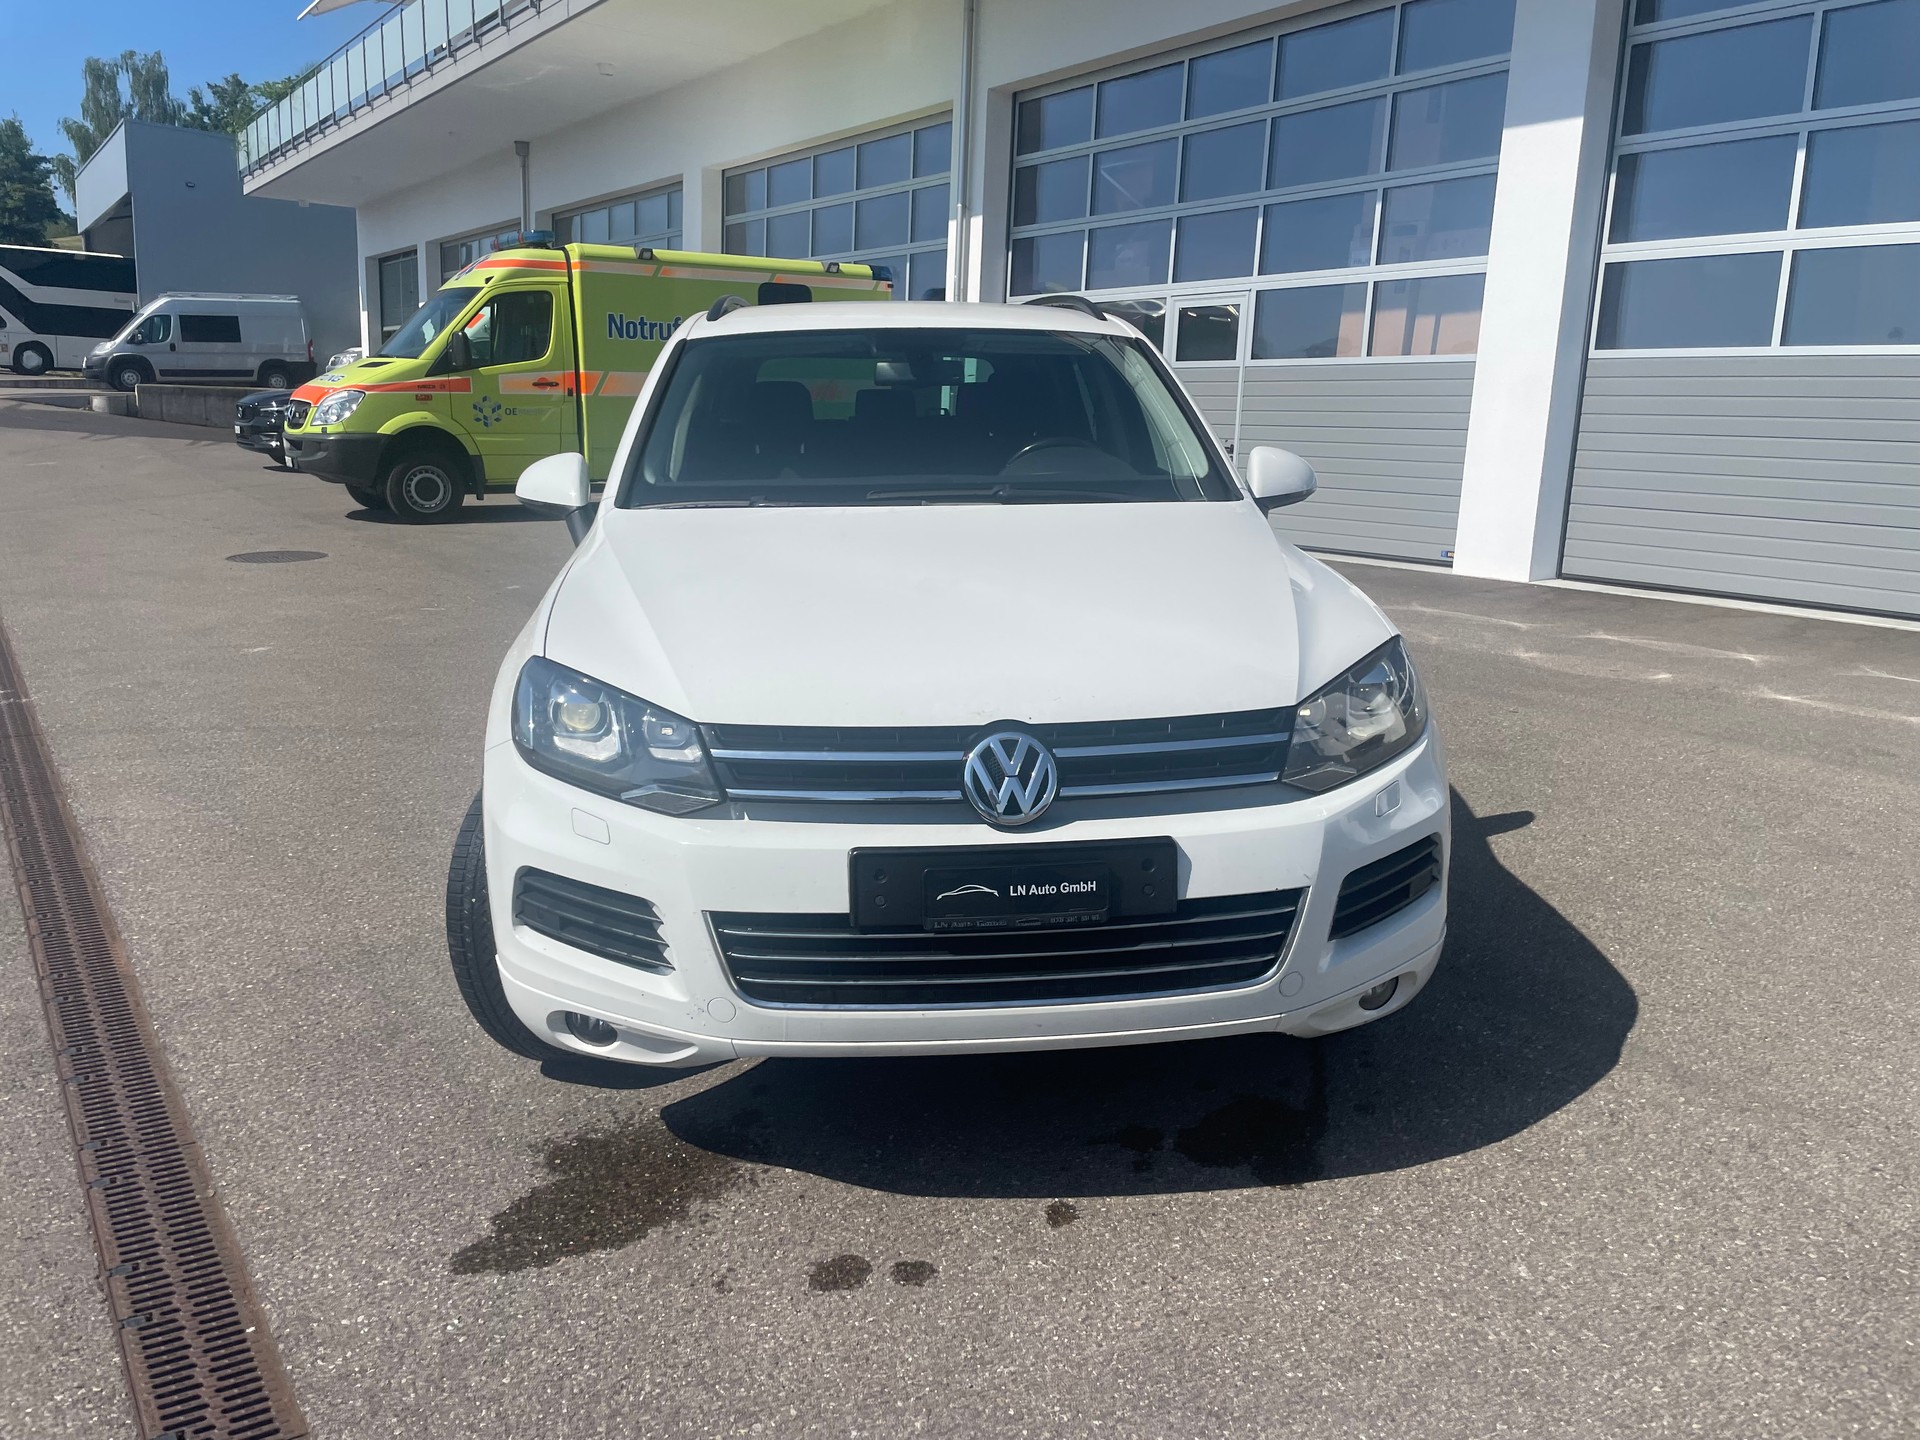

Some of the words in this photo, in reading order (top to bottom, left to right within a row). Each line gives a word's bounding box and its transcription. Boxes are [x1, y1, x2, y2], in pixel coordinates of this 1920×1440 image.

[1009, 885, 1026, 897] LN
[1028, 883, 1057, 896] Auto
[1060, 880, 1097, 894] GmbH
